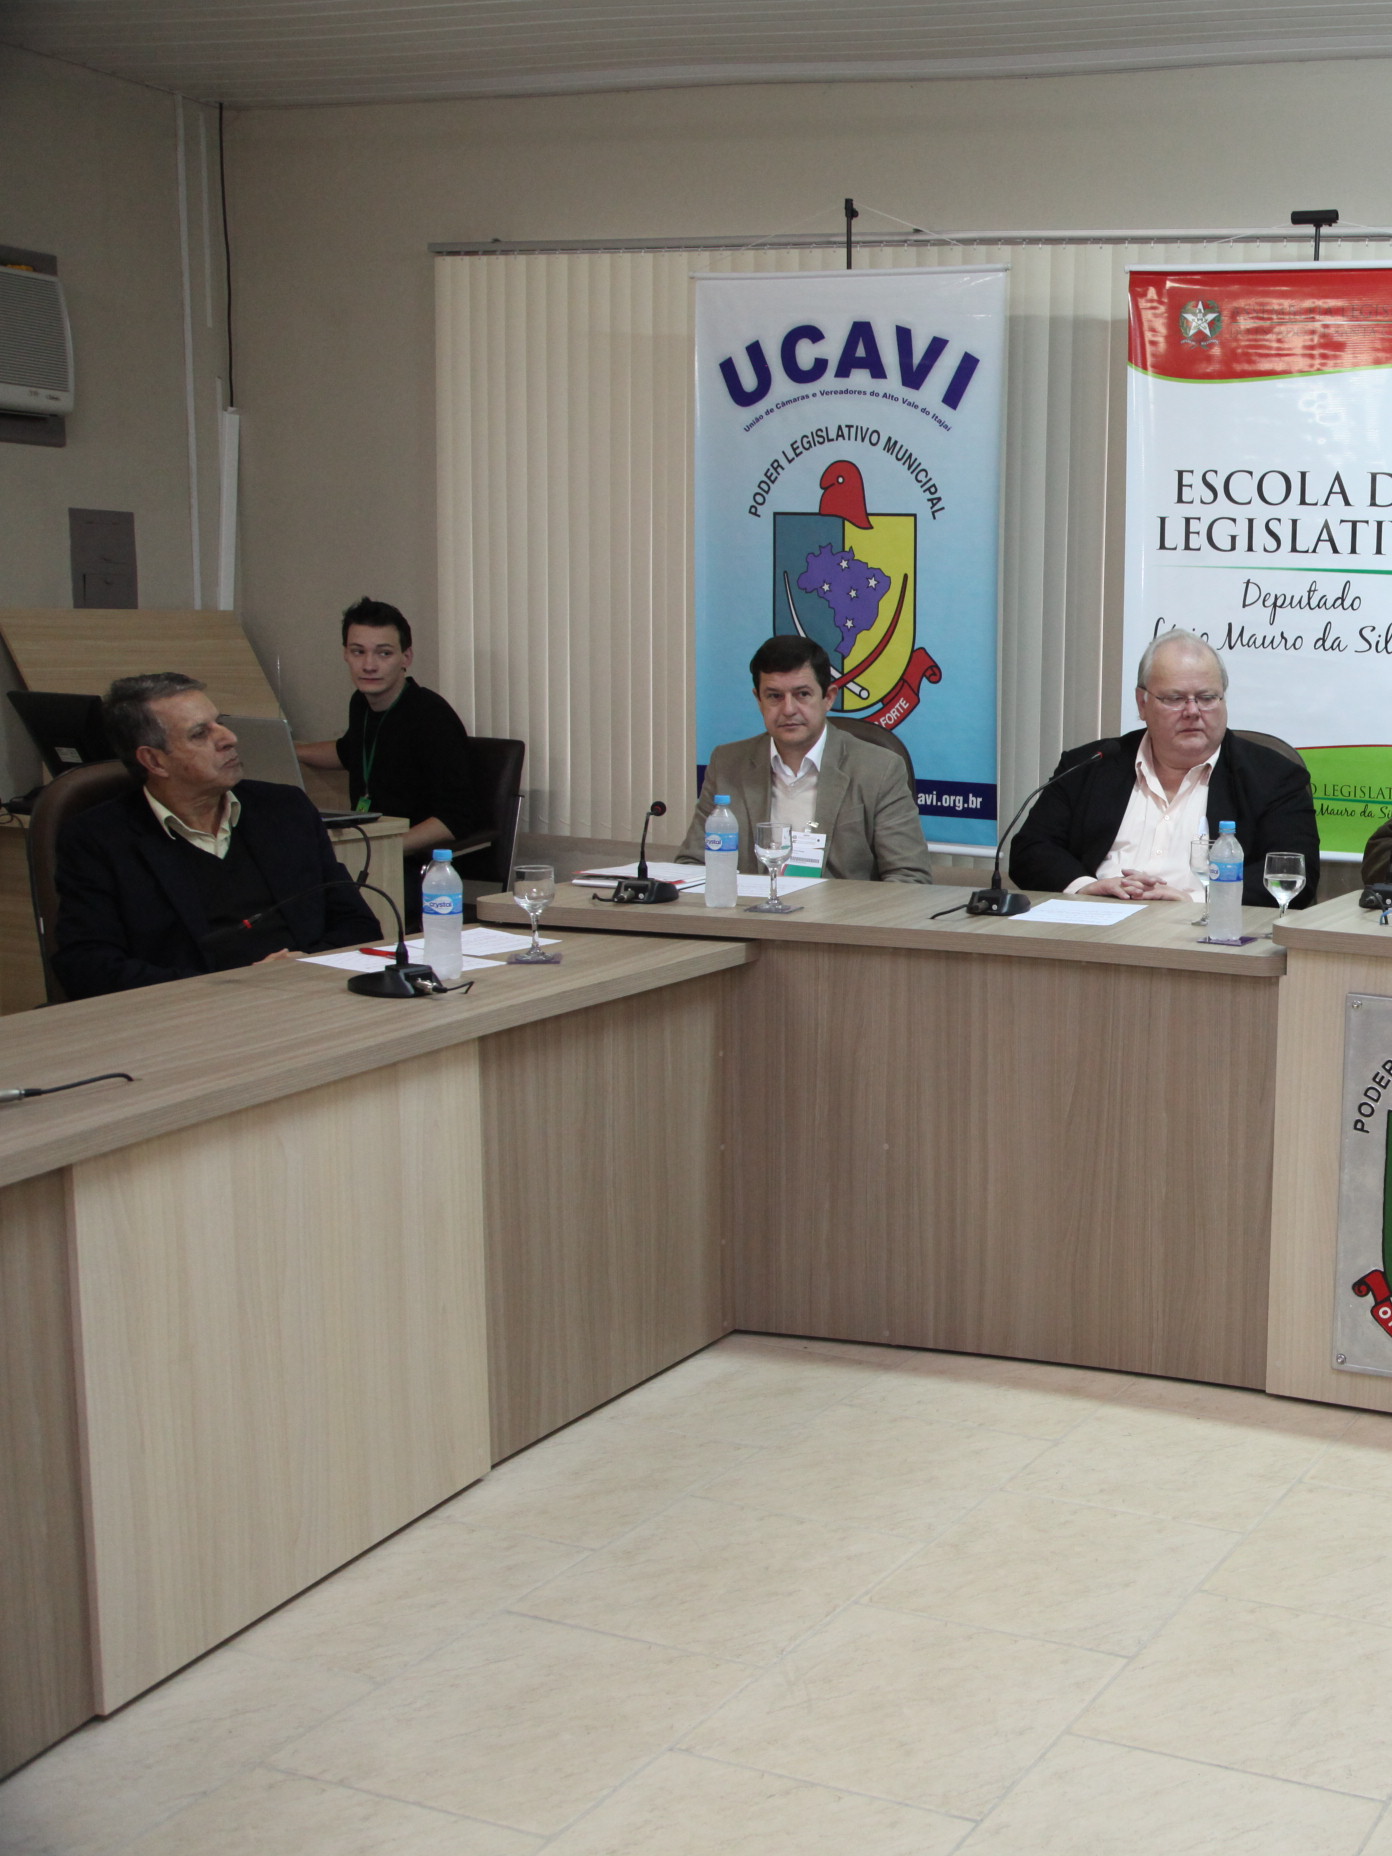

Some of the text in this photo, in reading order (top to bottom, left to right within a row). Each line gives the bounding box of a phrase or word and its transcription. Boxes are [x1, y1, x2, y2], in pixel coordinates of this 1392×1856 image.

[1231, 304, 1334, 319] ASSEMBEIA
[719, 321, 980, 411] UCAVI
[744, 413, 764, 433] União
[765, 407, 775, 416] de
[775, 393, 810, 410] Câmaras
[819, 388, 867, 396] Vereadores
[869, 390, 880, 398] do
[882, 392, 899, 402] Alto
[901, 397, 919, 410] Vale
[920, 405, 931, 416] do
[748, 424, 946, 520] PODER LEGISLATIVO MUNICIPAL
[1174, 468, 1354, 507] ESCOLA
[1241, 578, 1362, 626] Deputado
[1216, 621, 1304, 651] Mauro
[1313, 620, 1349, 653] da
[880, 697, 910, 728] FORTE
[917, 791, 983, 811] avi.org.br
[1316, 803, 1356, 817] Mauro
[1360, 804, 1376, 818] da
[1378, 1306, 1391, 1319] O
